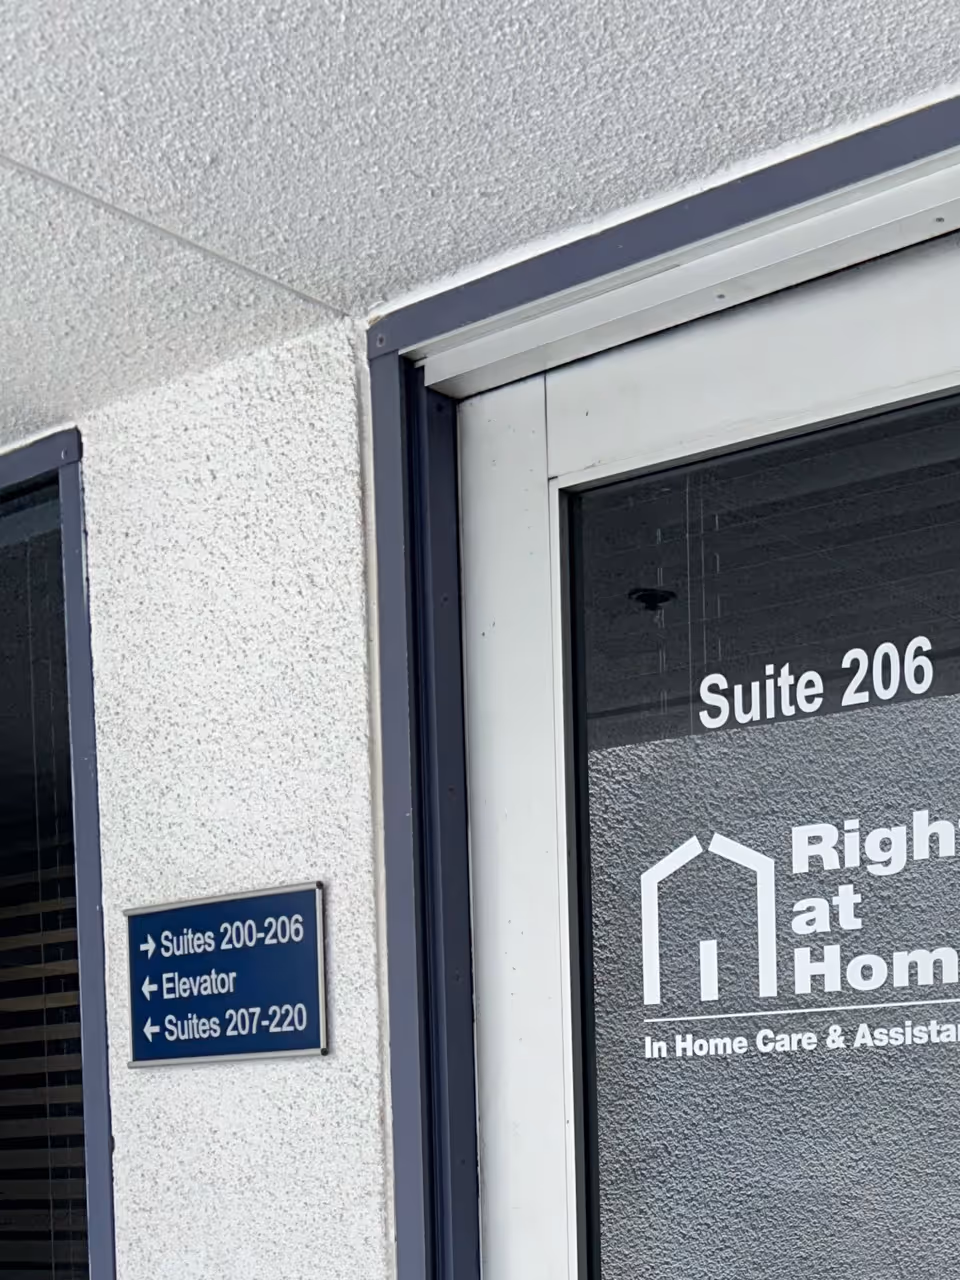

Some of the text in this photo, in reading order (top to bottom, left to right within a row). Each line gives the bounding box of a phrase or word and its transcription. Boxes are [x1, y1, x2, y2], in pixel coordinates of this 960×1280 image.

[699, 636, 935, 729] Suite 206
[791, 884, 862, 935] at
[160, 914, 304, 958] Suites 200-206
[162, 968, 237, 1000] Elevator
[164, 1003, 307, 1041] Suites 207-220
[644, 1036, 667, 1059] In
[675, 1033, 748, 1057] Home
[756, 1028, 818, 1052] Care
[826, 1024, 846, 1049] &
